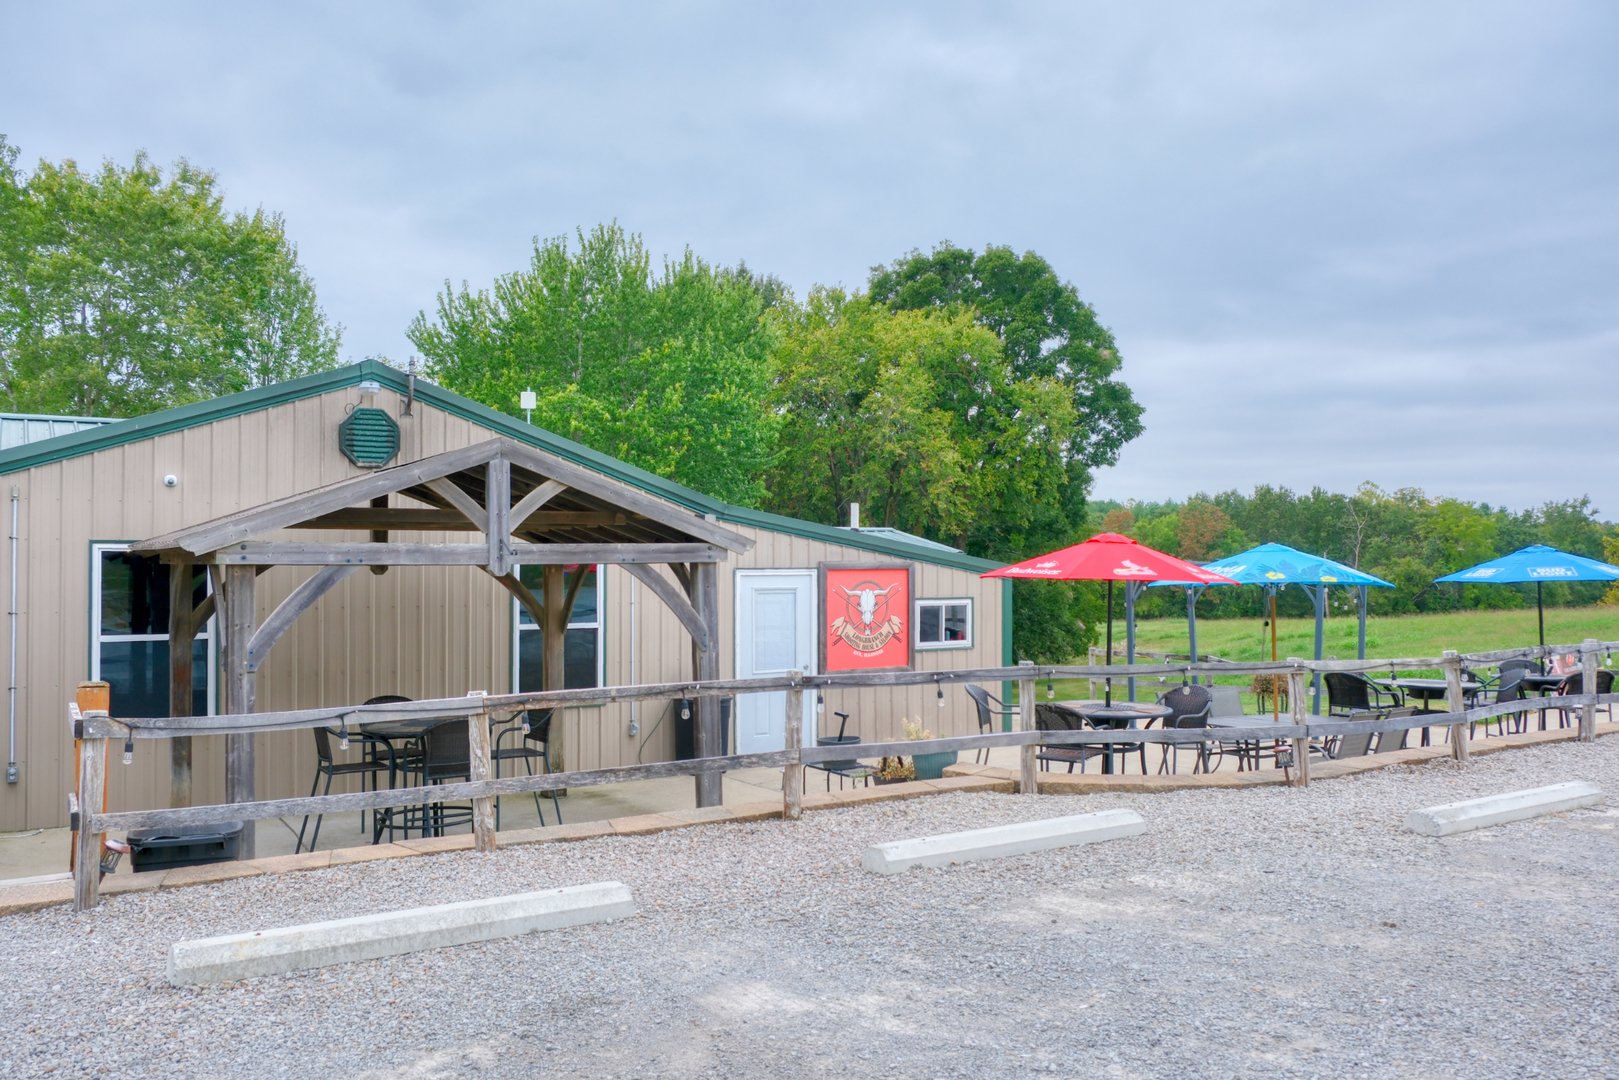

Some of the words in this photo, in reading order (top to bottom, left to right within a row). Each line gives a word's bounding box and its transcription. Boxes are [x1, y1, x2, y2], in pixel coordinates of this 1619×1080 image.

[1004, 567, 1062, 575] Budweiser
[843, 632, 861, 649] SHOOTING
[861, 643, 875, 651] HOUSE
[878, 630, 892, 646] SALOON
[852, 631, 883, 643] LONGBRANCH
[863, 649, 883, 657] ILLINOIS
